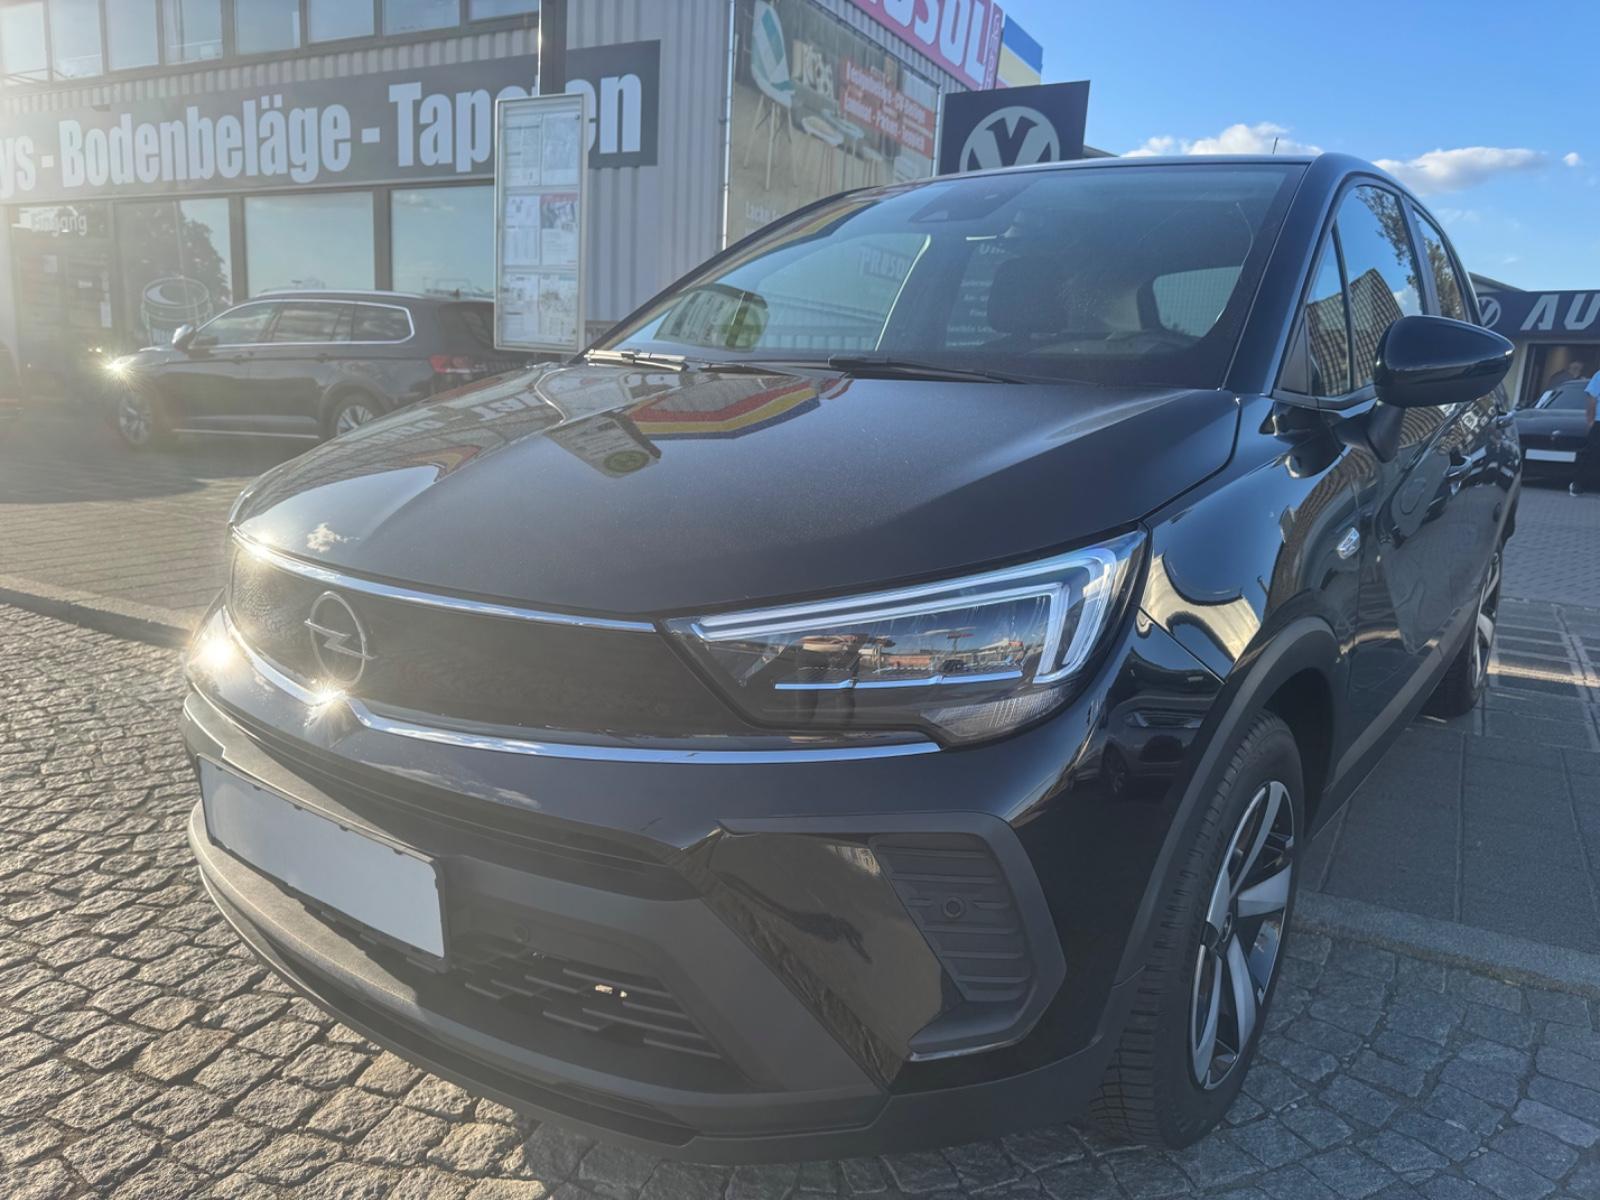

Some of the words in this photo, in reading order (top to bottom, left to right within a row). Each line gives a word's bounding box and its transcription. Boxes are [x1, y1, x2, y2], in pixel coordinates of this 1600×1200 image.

[59, 95, 351, 188] Bodenbeläge
[389, 73, 642, 173] Tapn
[1520, 293, 1600, 331] AU
